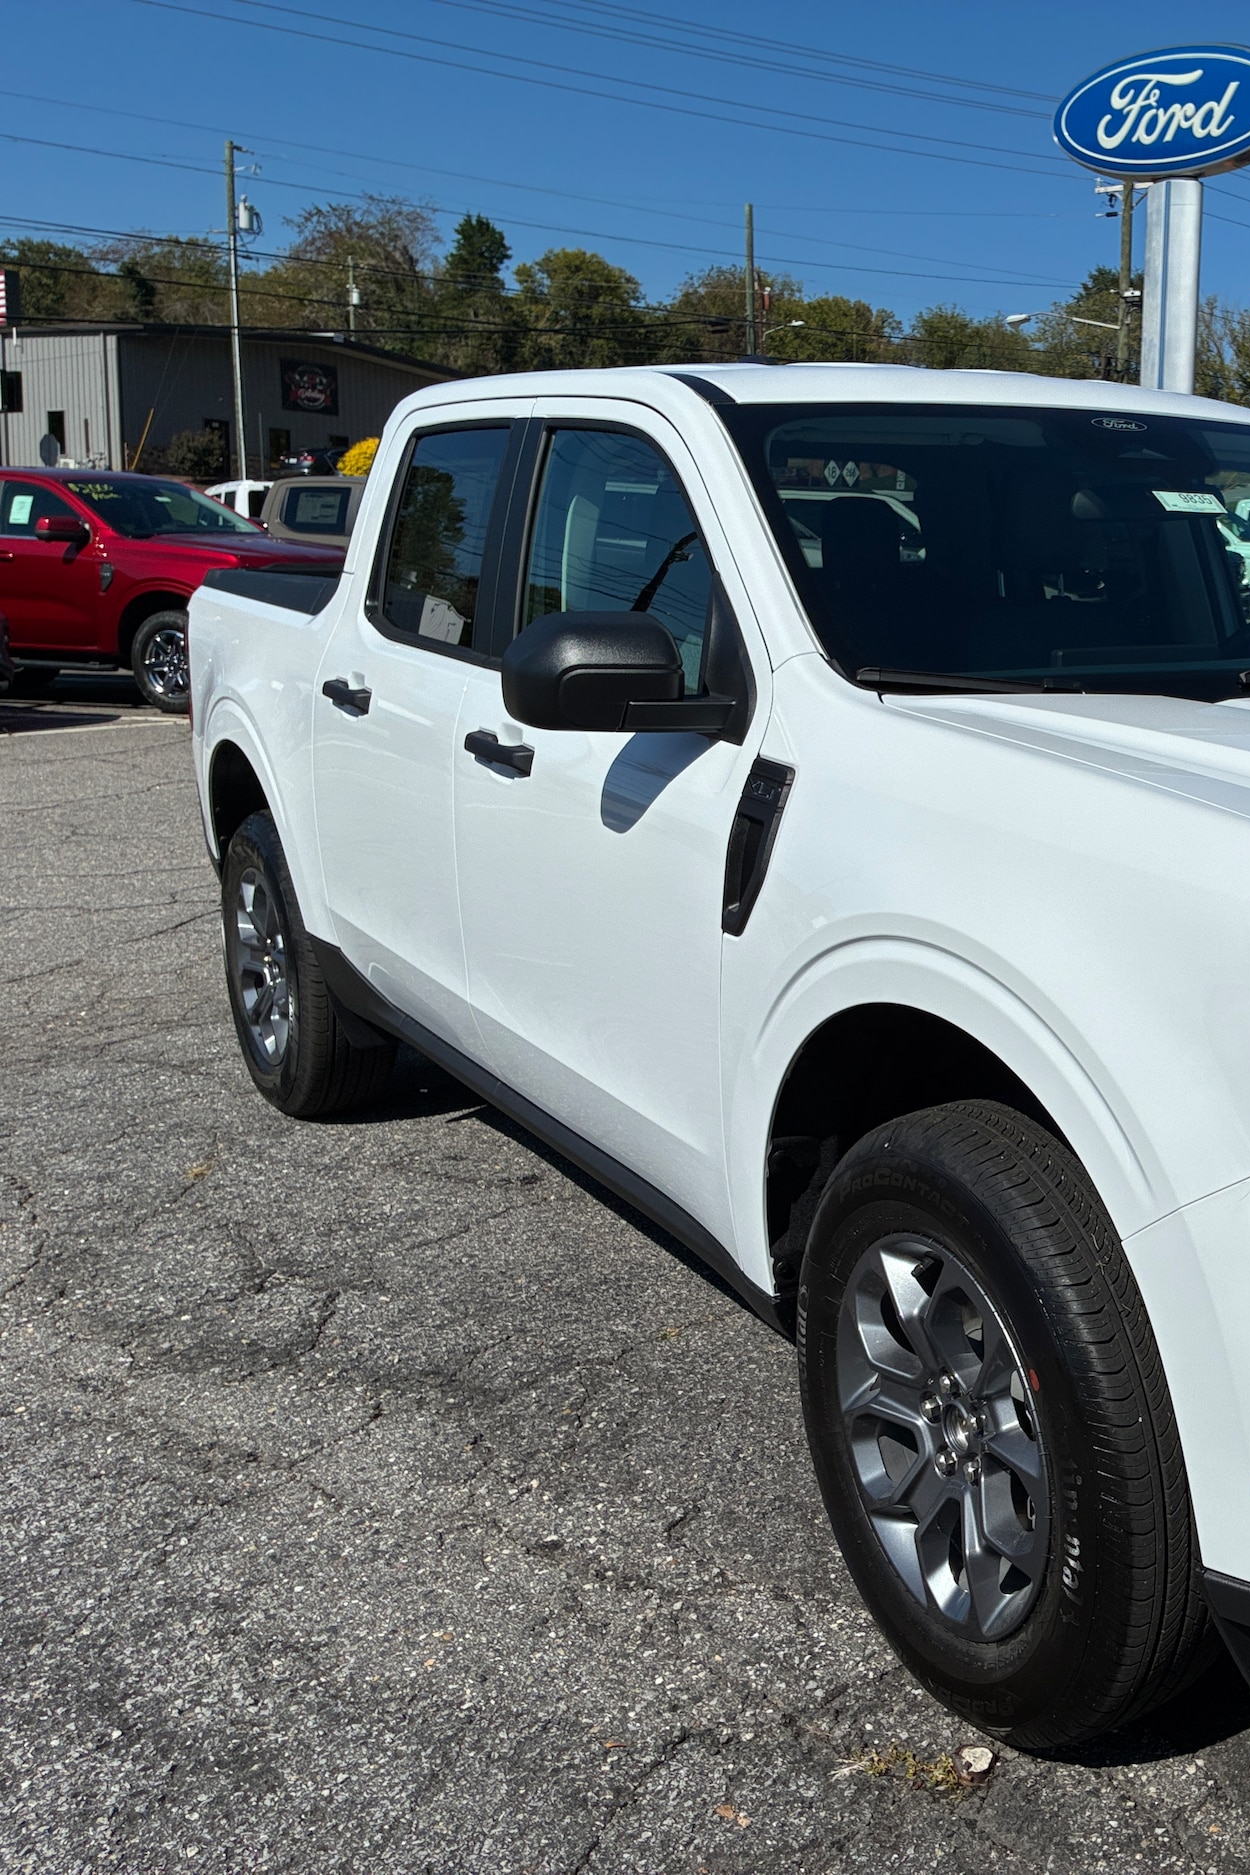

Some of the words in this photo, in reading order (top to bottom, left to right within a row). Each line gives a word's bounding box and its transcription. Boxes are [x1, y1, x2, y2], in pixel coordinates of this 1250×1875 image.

[1097, 69, 1241, 150] Ford
[1102, 419, 1139, 430] Ford
[1178, 493, 1213, 505] 9835
